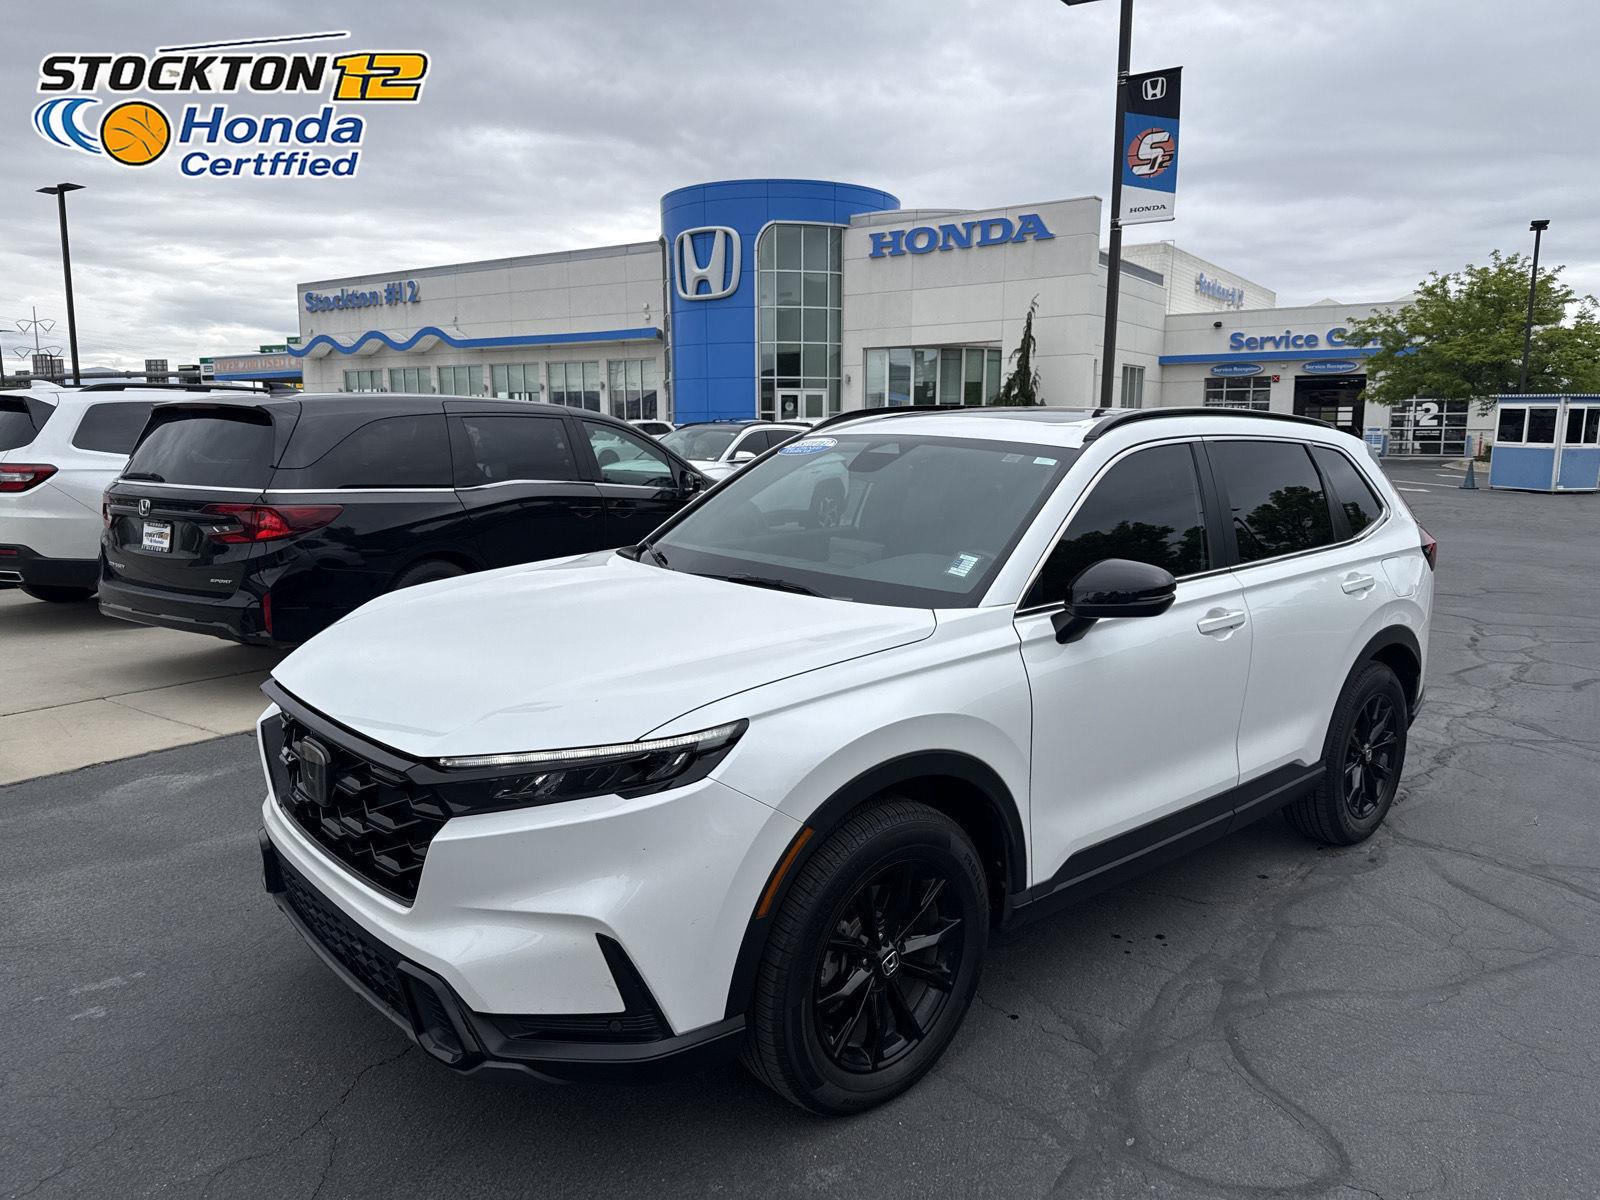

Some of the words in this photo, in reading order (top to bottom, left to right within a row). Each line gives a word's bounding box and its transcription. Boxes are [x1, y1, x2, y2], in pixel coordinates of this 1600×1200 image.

[1129, 203, 1167, 214] HONDA
[869, 213, 1056, 258] HONDA
[304, 288, 382, 313] Stockton
[384, 280, 420, 305] #12
[1229, 329, 1320, 351] Service
